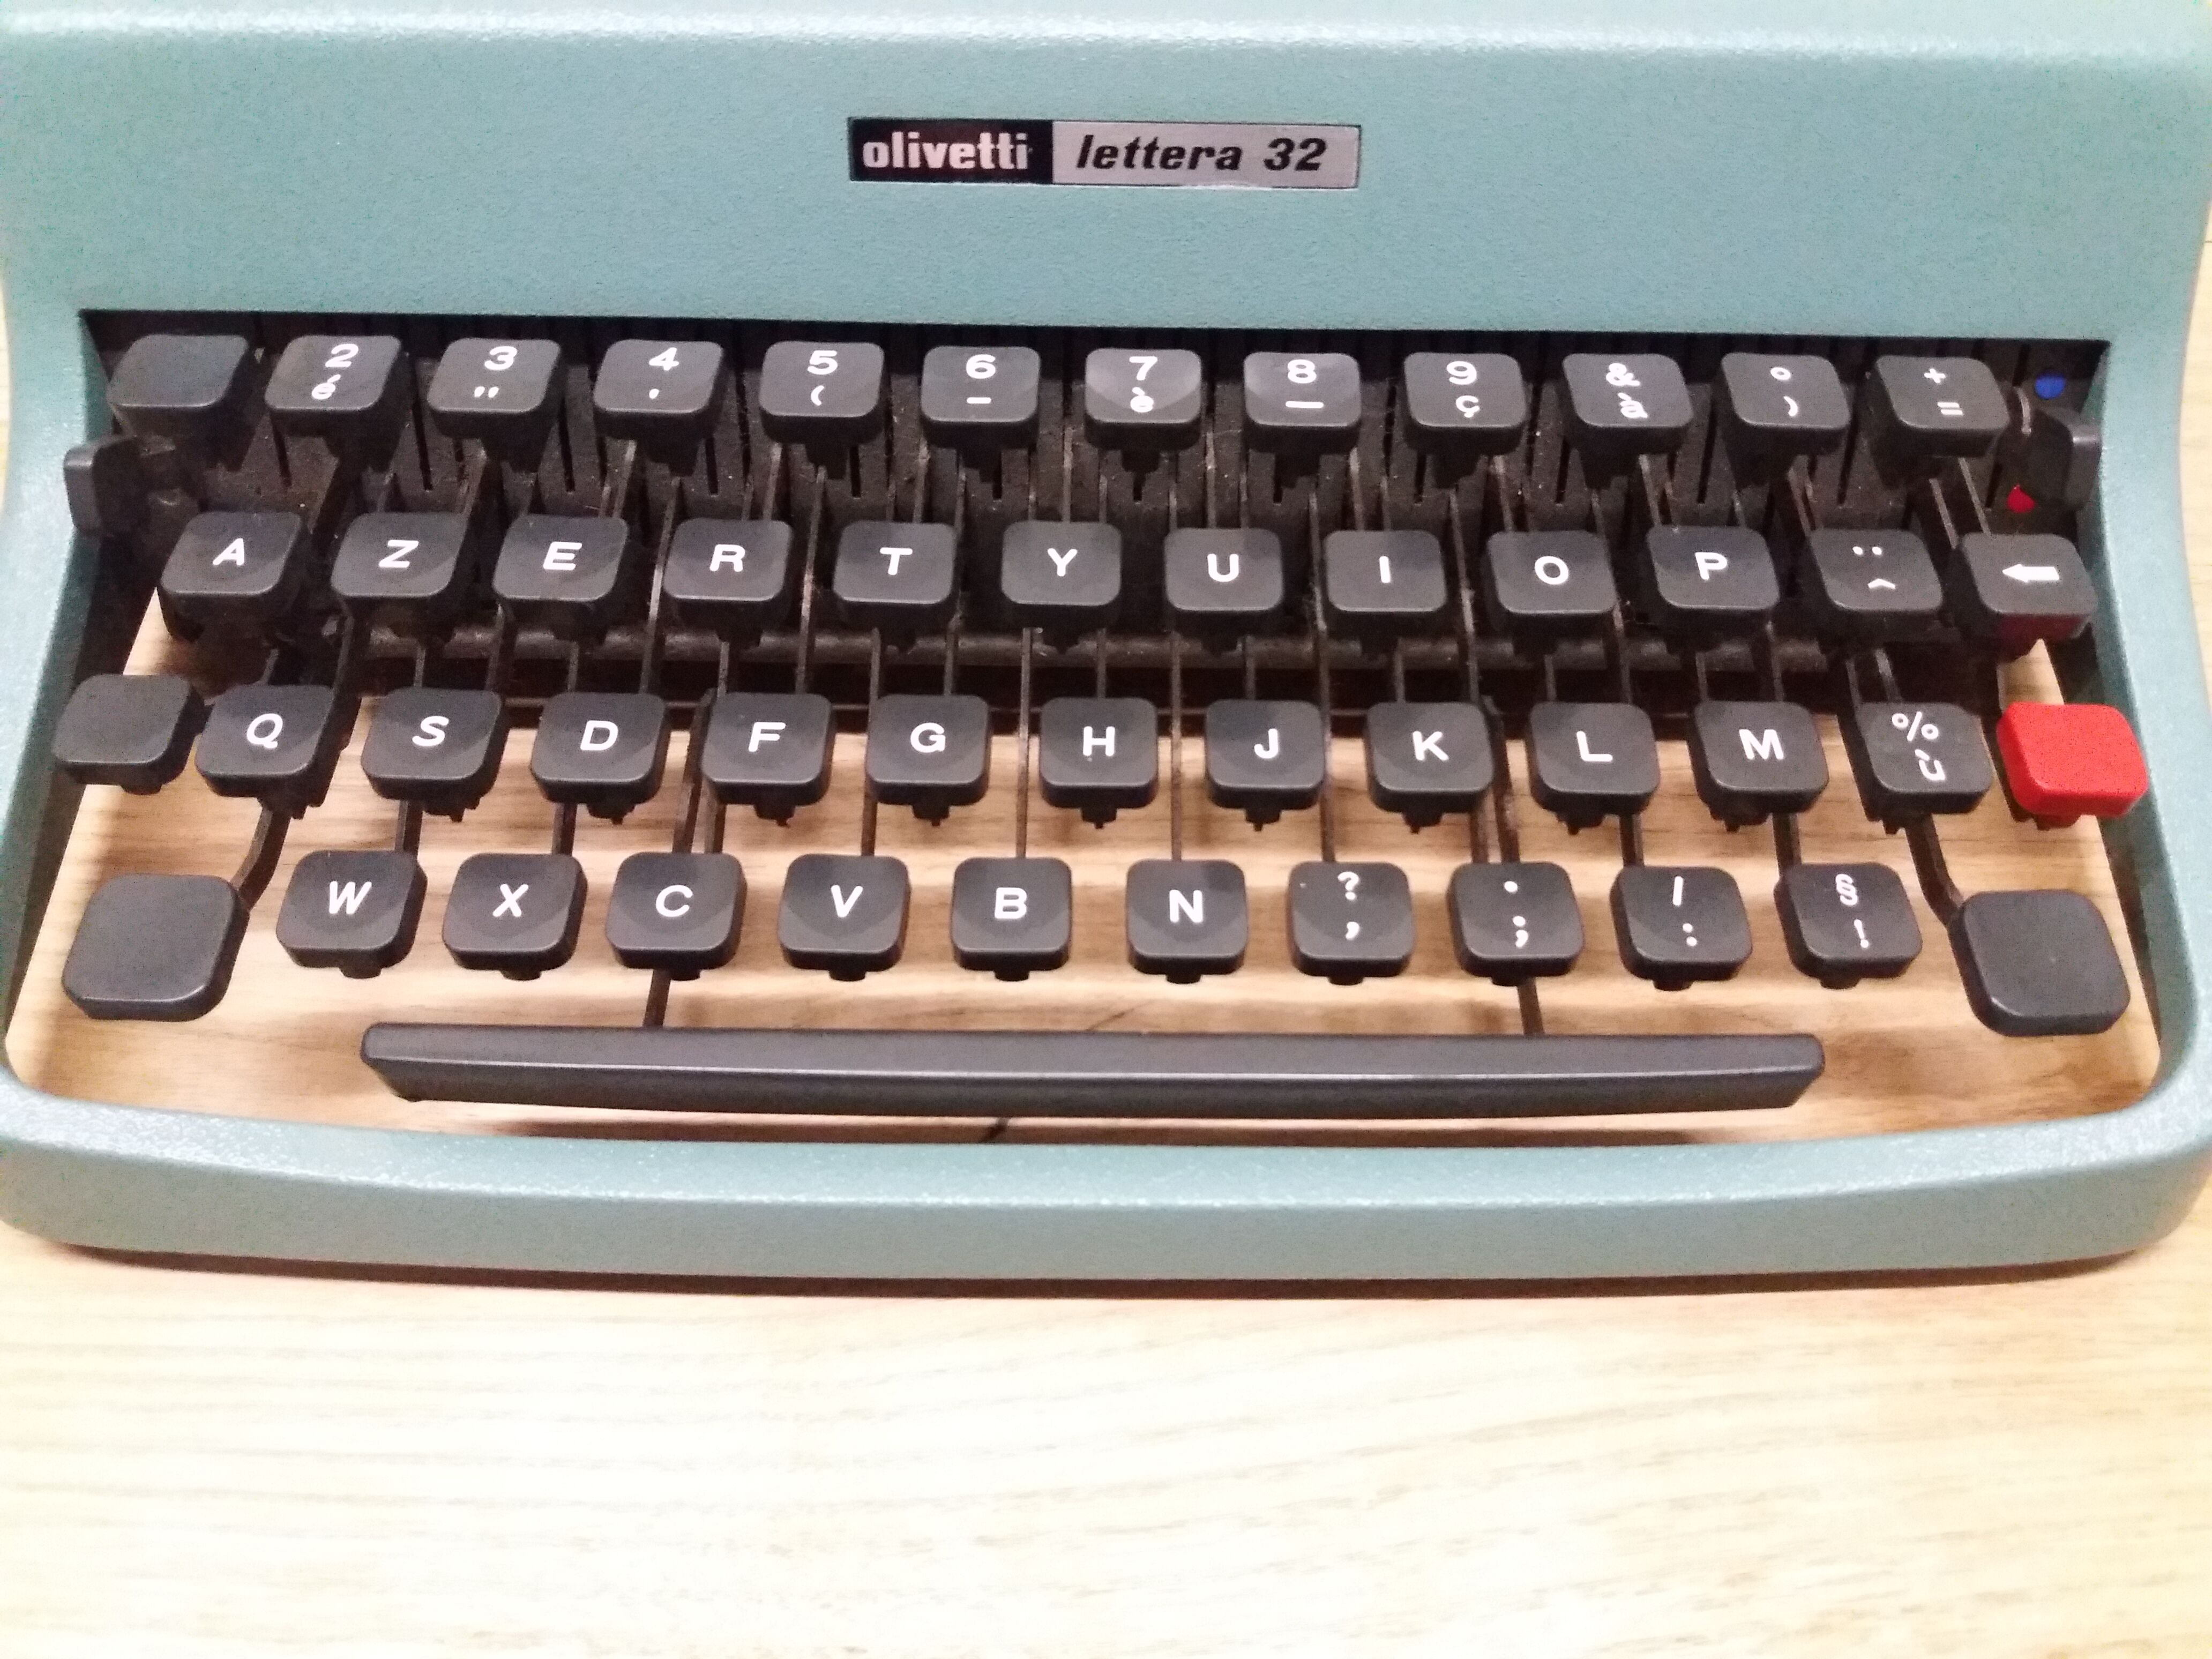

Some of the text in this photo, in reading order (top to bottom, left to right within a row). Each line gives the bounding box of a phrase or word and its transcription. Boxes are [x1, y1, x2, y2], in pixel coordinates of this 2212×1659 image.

[863, 131, 1327, 171] olivetti lettera 32
[324, 342, 360, 369] 2
[483, 345, 518, 372] 3
[648, 346, 681, 372] 4
[806, 349, 839, 376] 5
[965, 354, 997, 380] 6
[1128, 355, 1159, 382] 7
[311, 373, 342, 401] é
[1287, 359, 1317, 385] 8
[1446, 360, 1478, 386] 9
[1605, 362, 1642, 388] &
[1923, 368, 1947, 385] +
[810, 384, 825, 407] (
[1129, 386, 1156, 414] è
[1455, 395, 1481, 419] ç
[1617, 392, 1649, 420] à
[1783, 395, 1799, 418] )
[1937, 401, 1964, 417] =
[212, 537, 245, 566] A
[378, 539, 419, 569] Z
[542, 541, 582, 571] E
[709, 544, 746, 573] R
[879, 547, 913, 576] T
[1047, 548, 1078, 577] Y
[1694, 551, 1728, 581] P
[1207, 553, 1240, 583] U
[1378, 555, 1392, 584] I
[1534, 556, 1570, 586] O
[245, 713, 283, 750] Q
[412, 715, 450, 748] S
[579, 720, 619, 752] D
[748, 721, 786, 753] F
[910, 722, 946, 754] G
[1082, 726, 1116, 757] H
[1891, 711, 1940, 743] %
[1253, 728, 1280, 760] J
[1412, 730, 1449, 761] K
[1575, 730, 1613, 763] L
[1738, 729, 1785, 761] M
[1914, 749, 1947, 783] ù
[328, 880, 372, 916] W
[492, 883, 529, 918] X
[655, 884, 693, 918] C
[1337, 871, 1360, 901] ?
[1835, 873, 1859, 907] §
[831, 885, 864, 918] V
[994, 887, 1028, 921] B
[1169, 889, 1205, 924] N
[1512, 915, 1529, 950] ;
[1682, 923, 1698, 947] :
[1854, 918, 1871, 950] !
